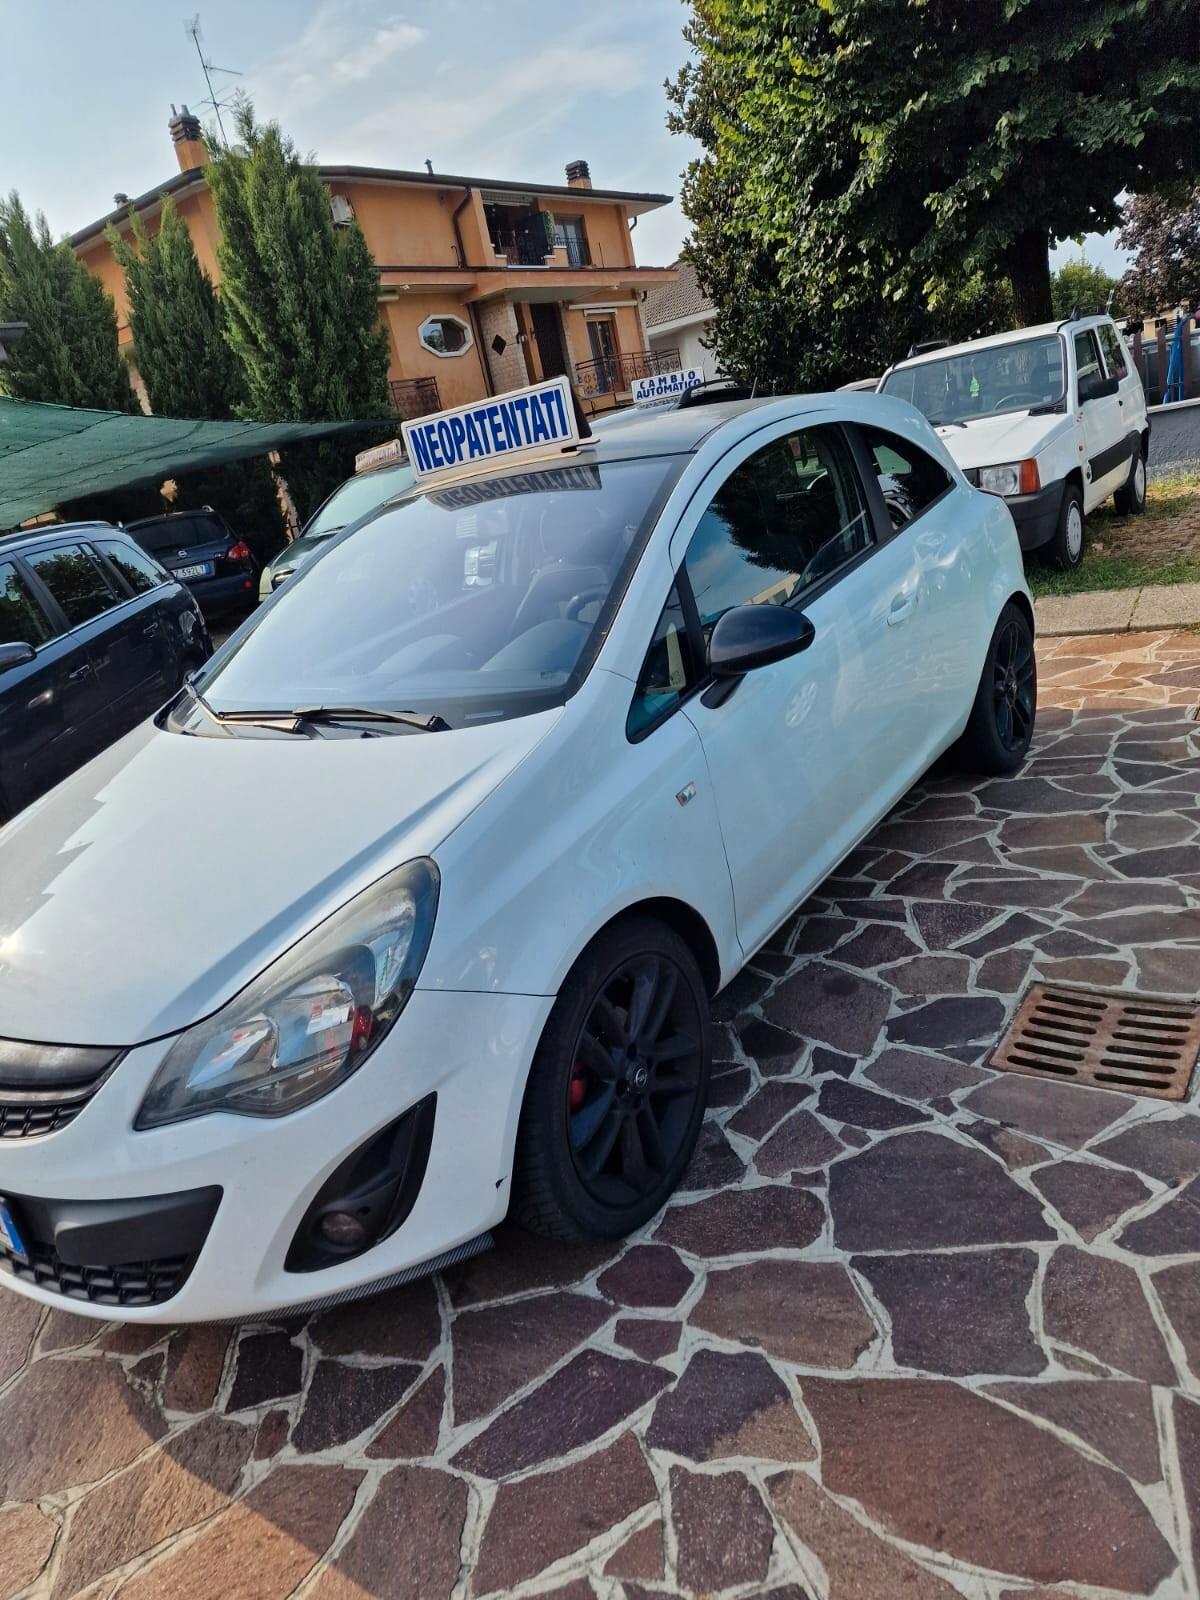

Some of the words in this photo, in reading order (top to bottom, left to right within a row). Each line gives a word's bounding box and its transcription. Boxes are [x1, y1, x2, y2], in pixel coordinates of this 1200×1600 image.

[637, 379, 700, 400] AUTOMATICO
[640, 371, 695, 389] CAMBIO
[410, 389, 568, 471] NEOPATENTATI
